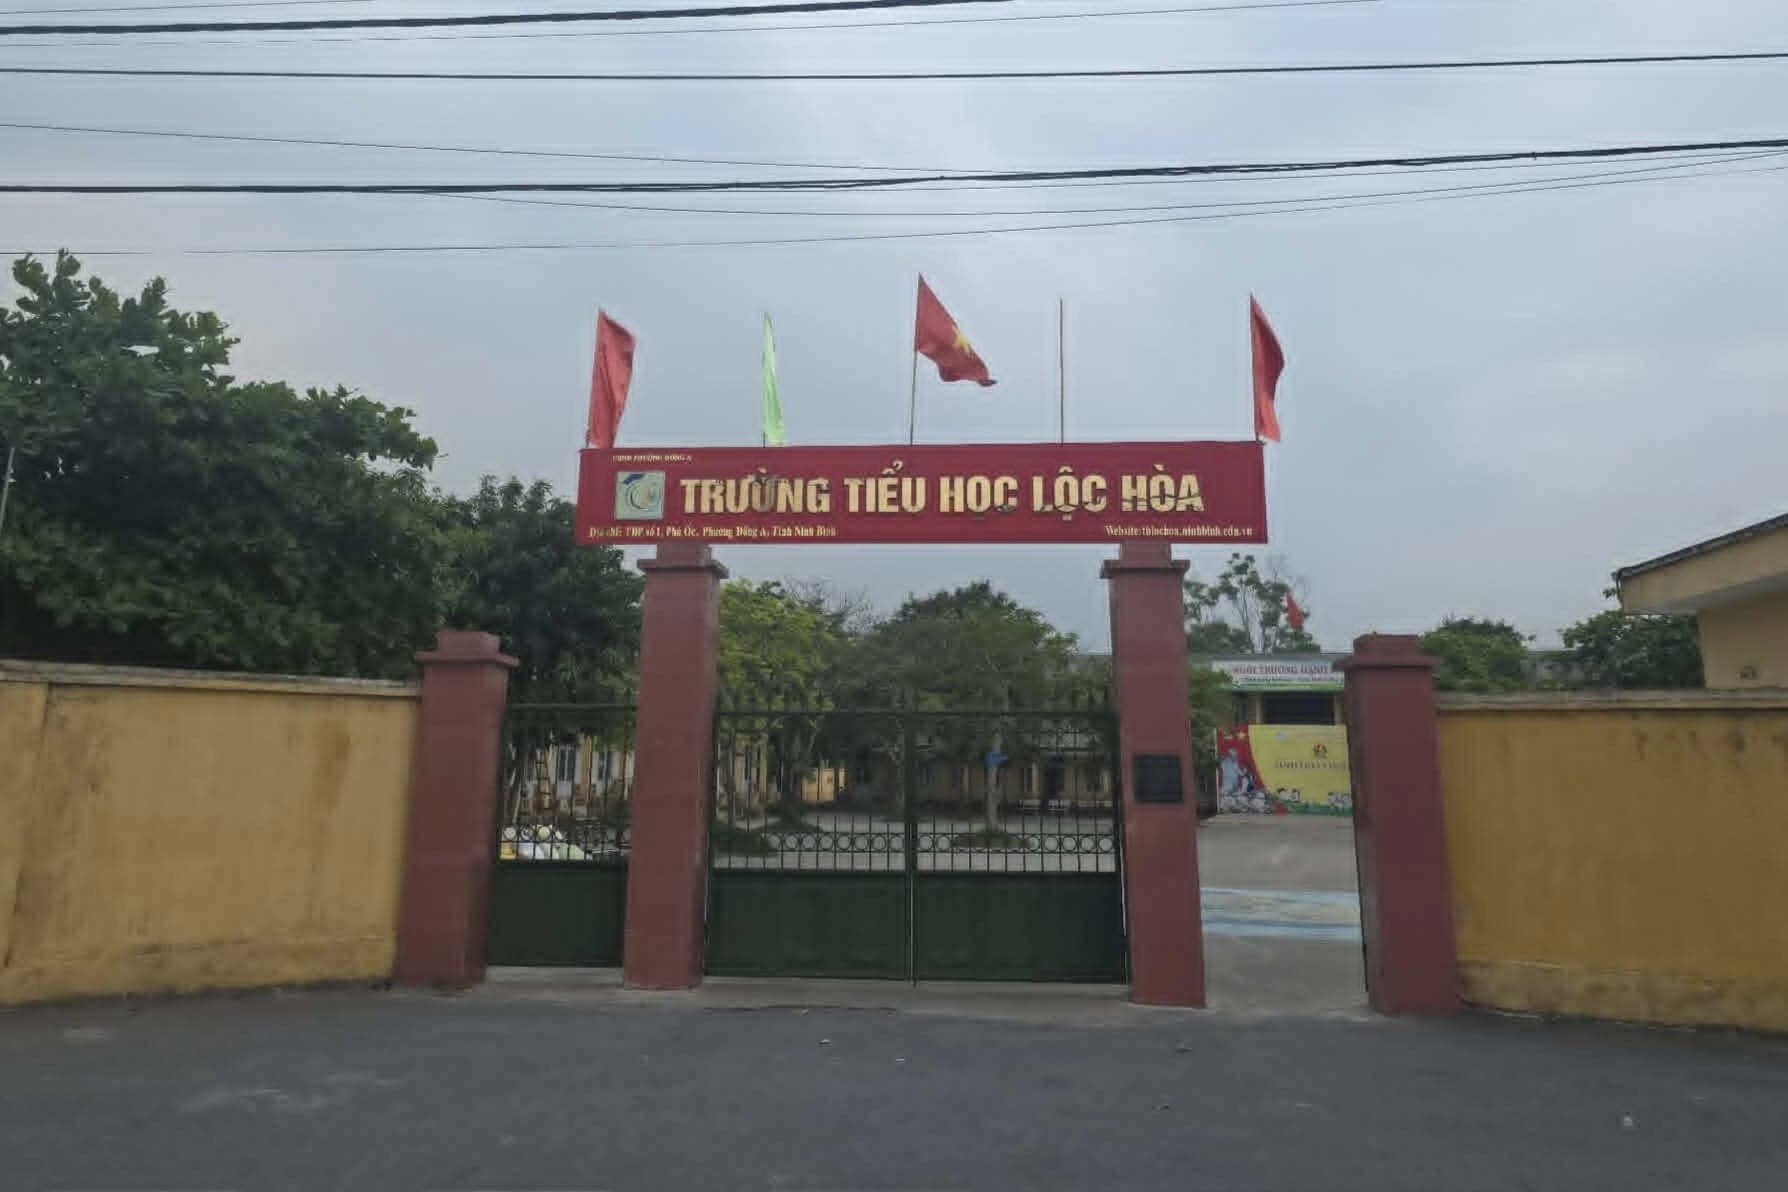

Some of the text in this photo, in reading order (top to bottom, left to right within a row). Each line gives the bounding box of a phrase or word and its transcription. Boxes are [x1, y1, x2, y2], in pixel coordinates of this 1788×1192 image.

[680, 467, 832, 514] TRƯỜNG
[844, 460, 927, 513] TIỂU
[1031, 465, 1107, 520] LỘC
[1121, 463, 1205, 513] HÒA
